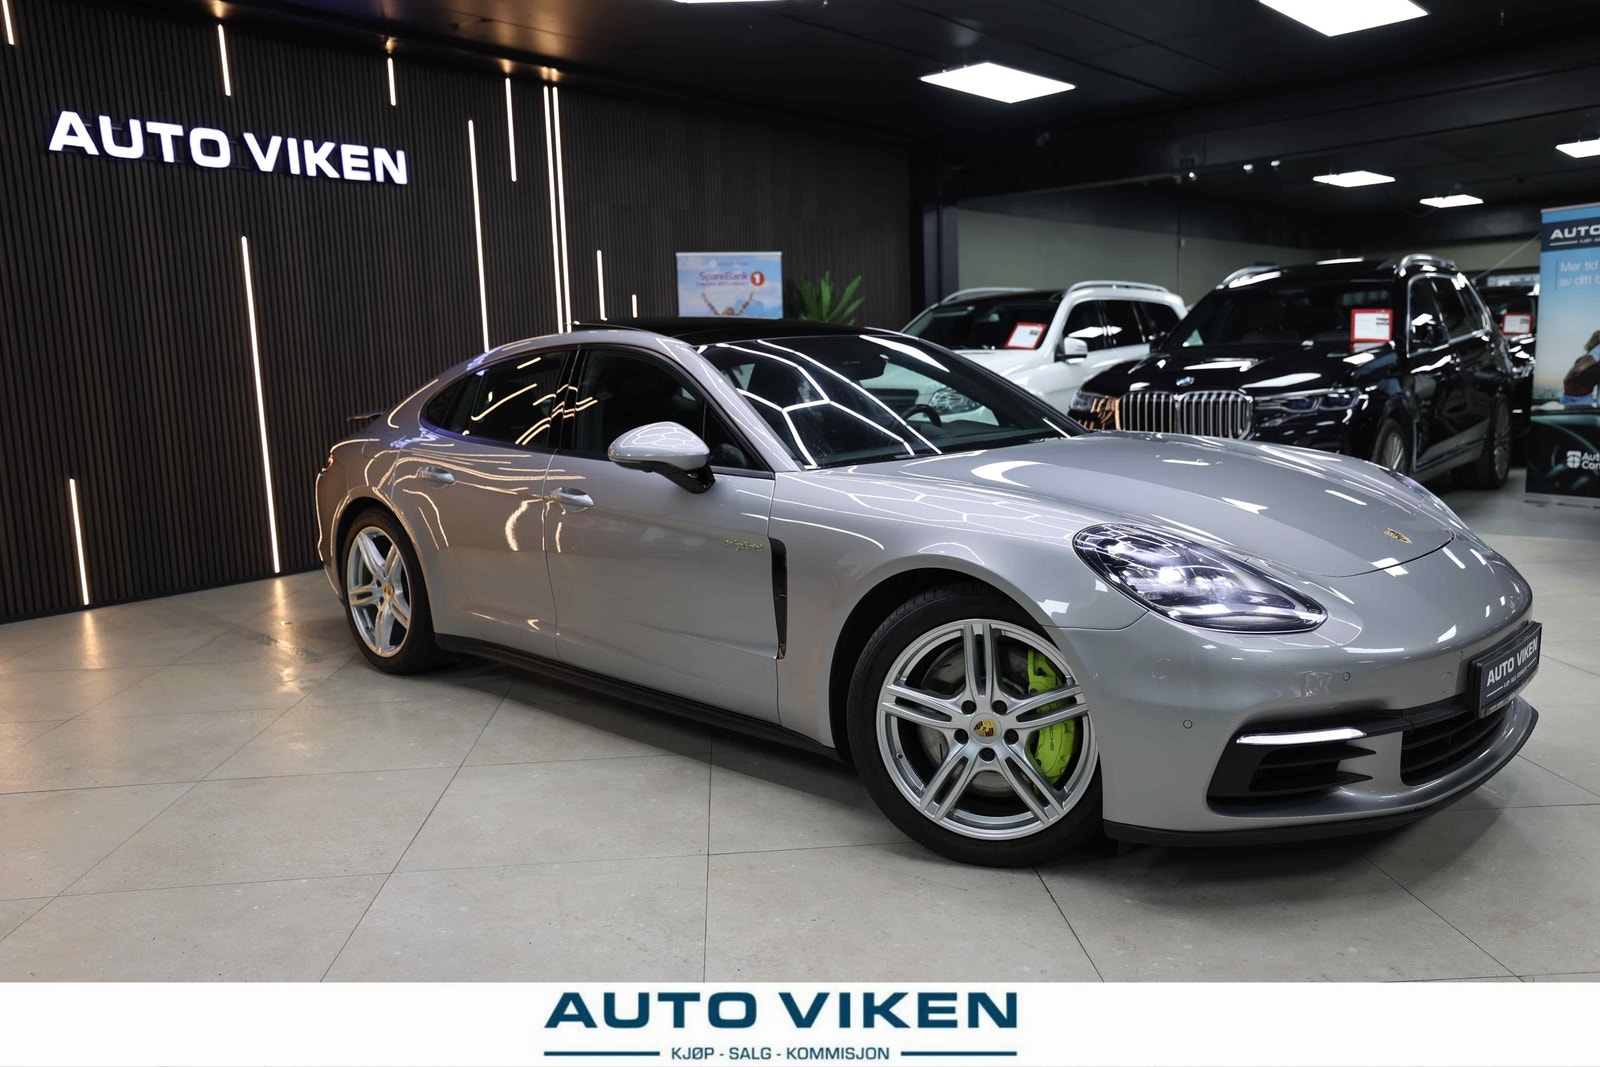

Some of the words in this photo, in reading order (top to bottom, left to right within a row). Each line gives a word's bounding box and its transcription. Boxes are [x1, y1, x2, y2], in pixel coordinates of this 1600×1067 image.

[49, 110, 230, 168] AUTO
[243, 132, 407, 185] VIKEN
[1550, 225, 1600, 239] AUTO
[1560, 261, 1580, 272] Mer
[1585, 260, 1599, 270] tid
[699, 272, 748, 282] SpareBank
[1574, 275, 1592, 285] ditt
[1486, 657, 1514, 688] AUTO
[1516, 636, 1538, 667] VIKEN
